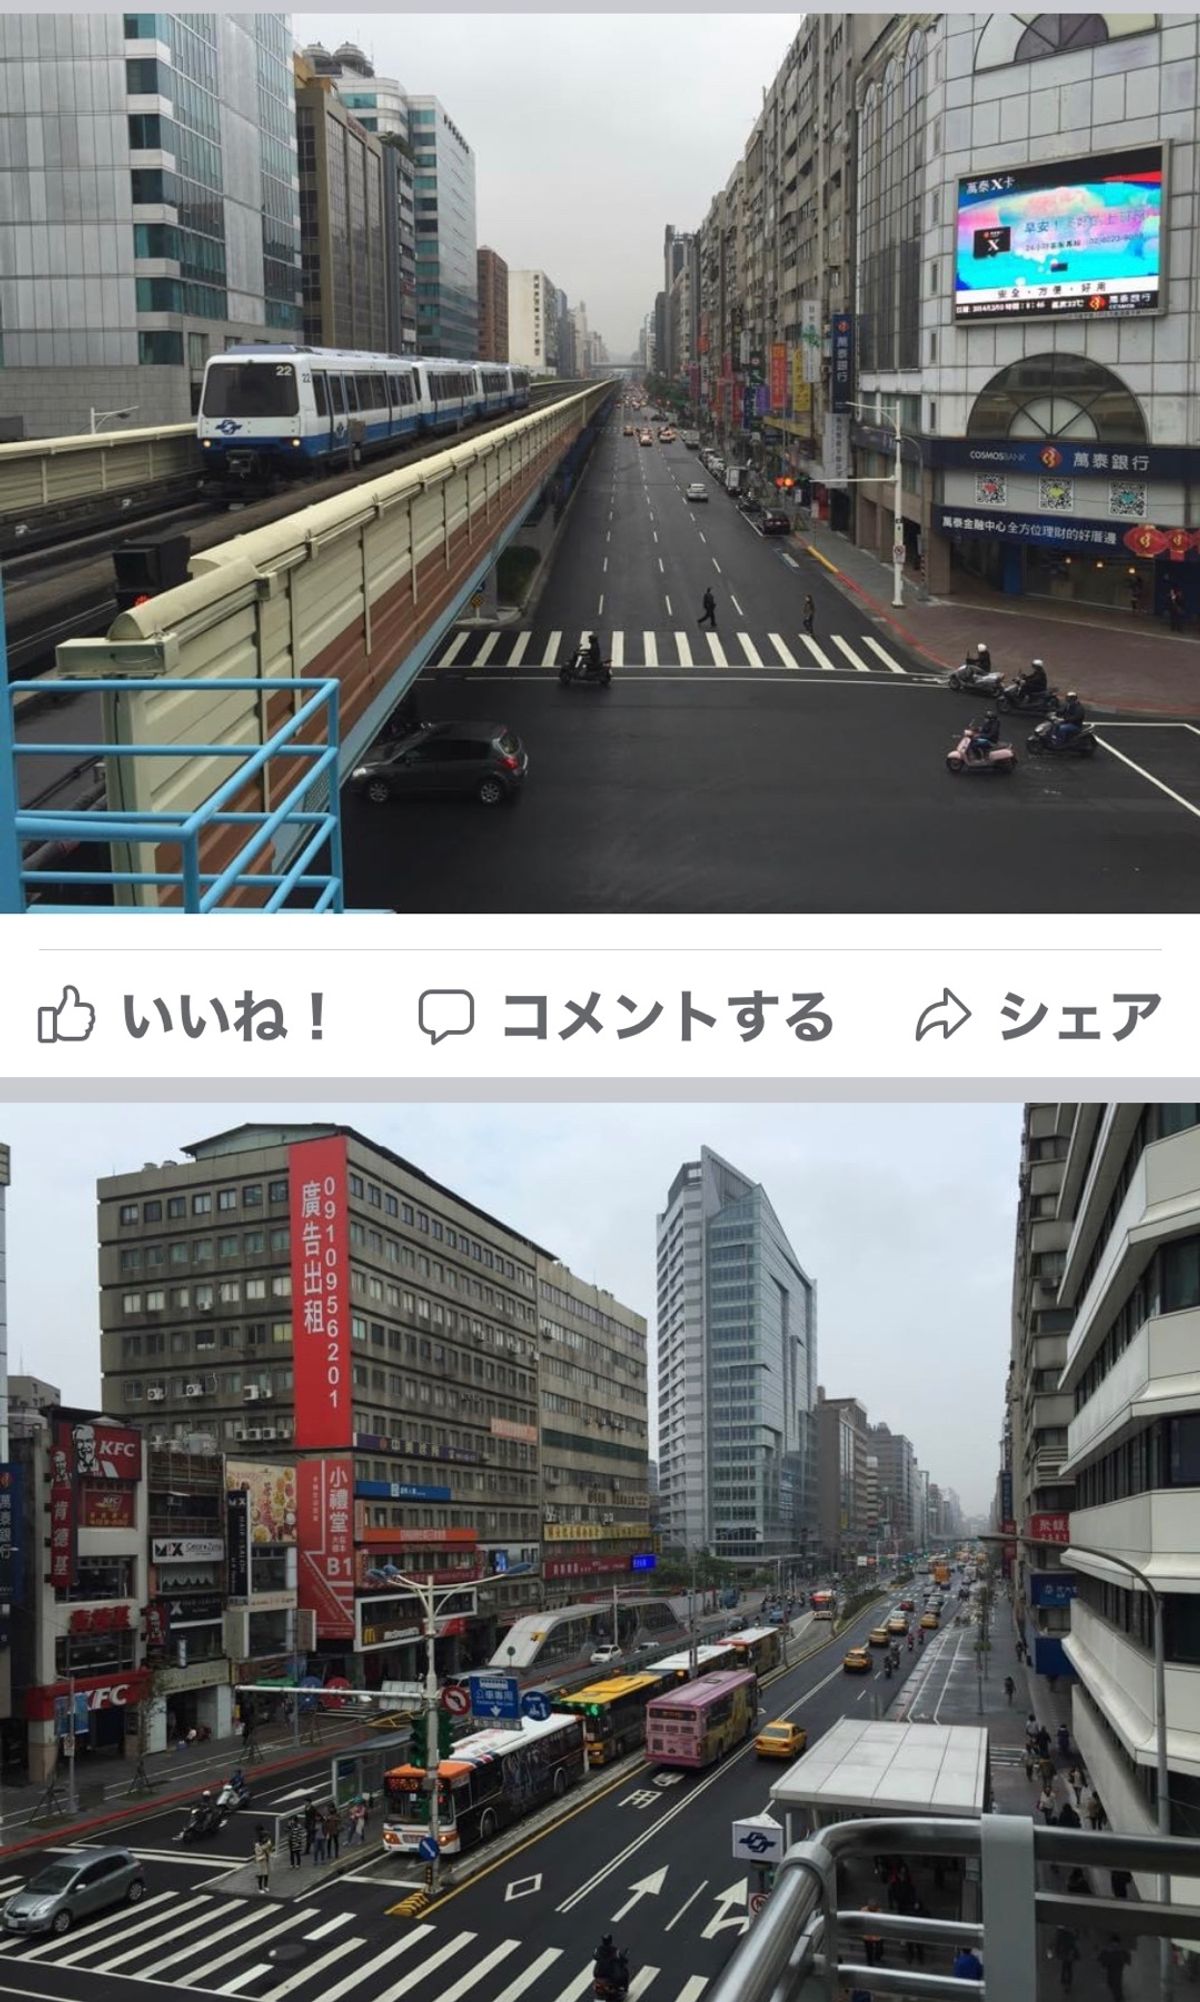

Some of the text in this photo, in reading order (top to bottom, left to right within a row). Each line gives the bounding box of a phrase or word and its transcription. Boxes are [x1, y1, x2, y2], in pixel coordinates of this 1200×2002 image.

[276, 366, 292, 376] 22
[302, 373, 311, 383] 22
[1073, 452, 1150, 471] 萬泰銀行
[302, 1180, 324, 1334] 廣告出租
[324, 1176, 340, 1408] 0910956201
[100, 1441, 135, 1457] KFC
[329, 1466, 349, 1533] 小禮堂
[53, 1501, 69, 1576] 肯德基
[327, 1557, 352, 1576] B1
